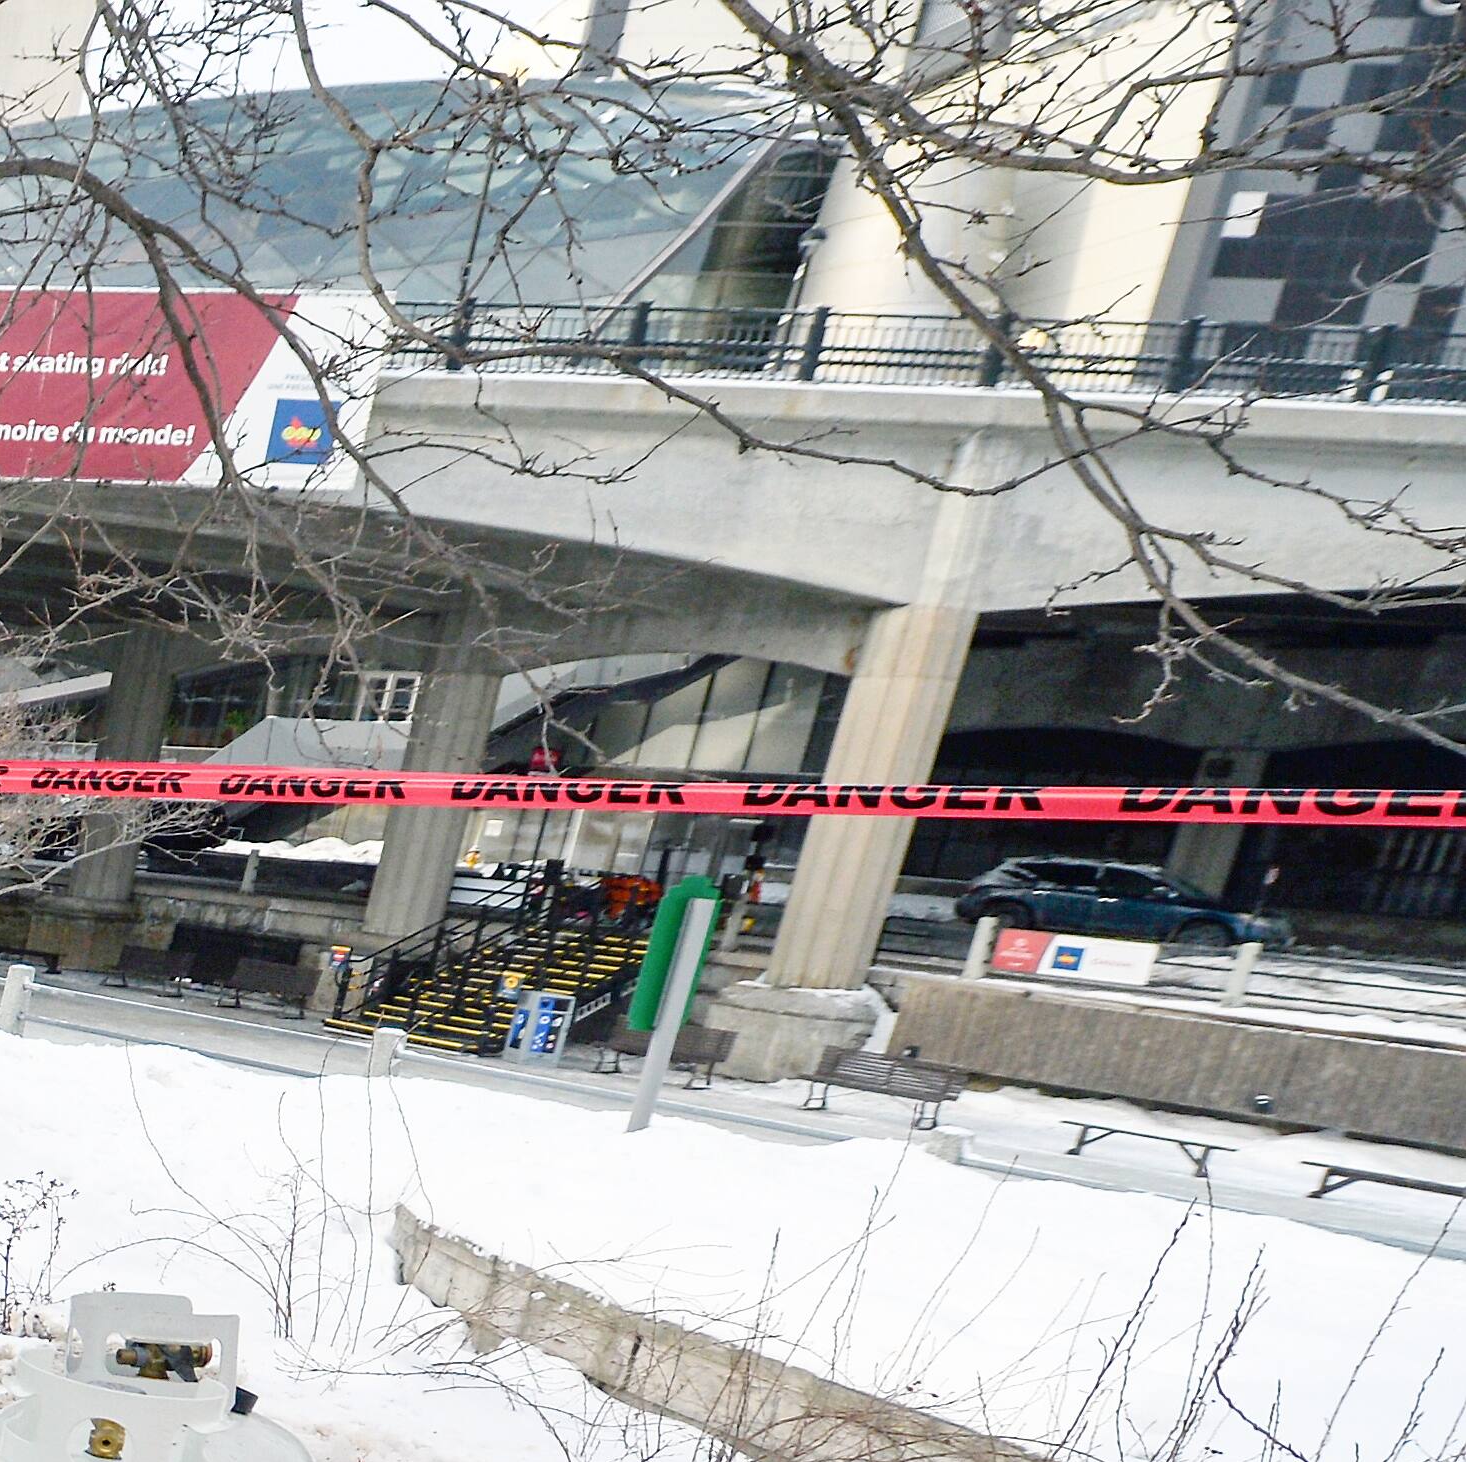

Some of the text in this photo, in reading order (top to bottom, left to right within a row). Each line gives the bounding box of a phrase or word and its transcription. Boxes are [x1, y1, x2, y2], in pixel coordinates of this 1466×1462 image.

[12, 351, 106, 379] skating
[98, 423, 197, 446] monde!
[30, 766, 193, 794] DANGER
[218, 773, 407, 800] DANGER
